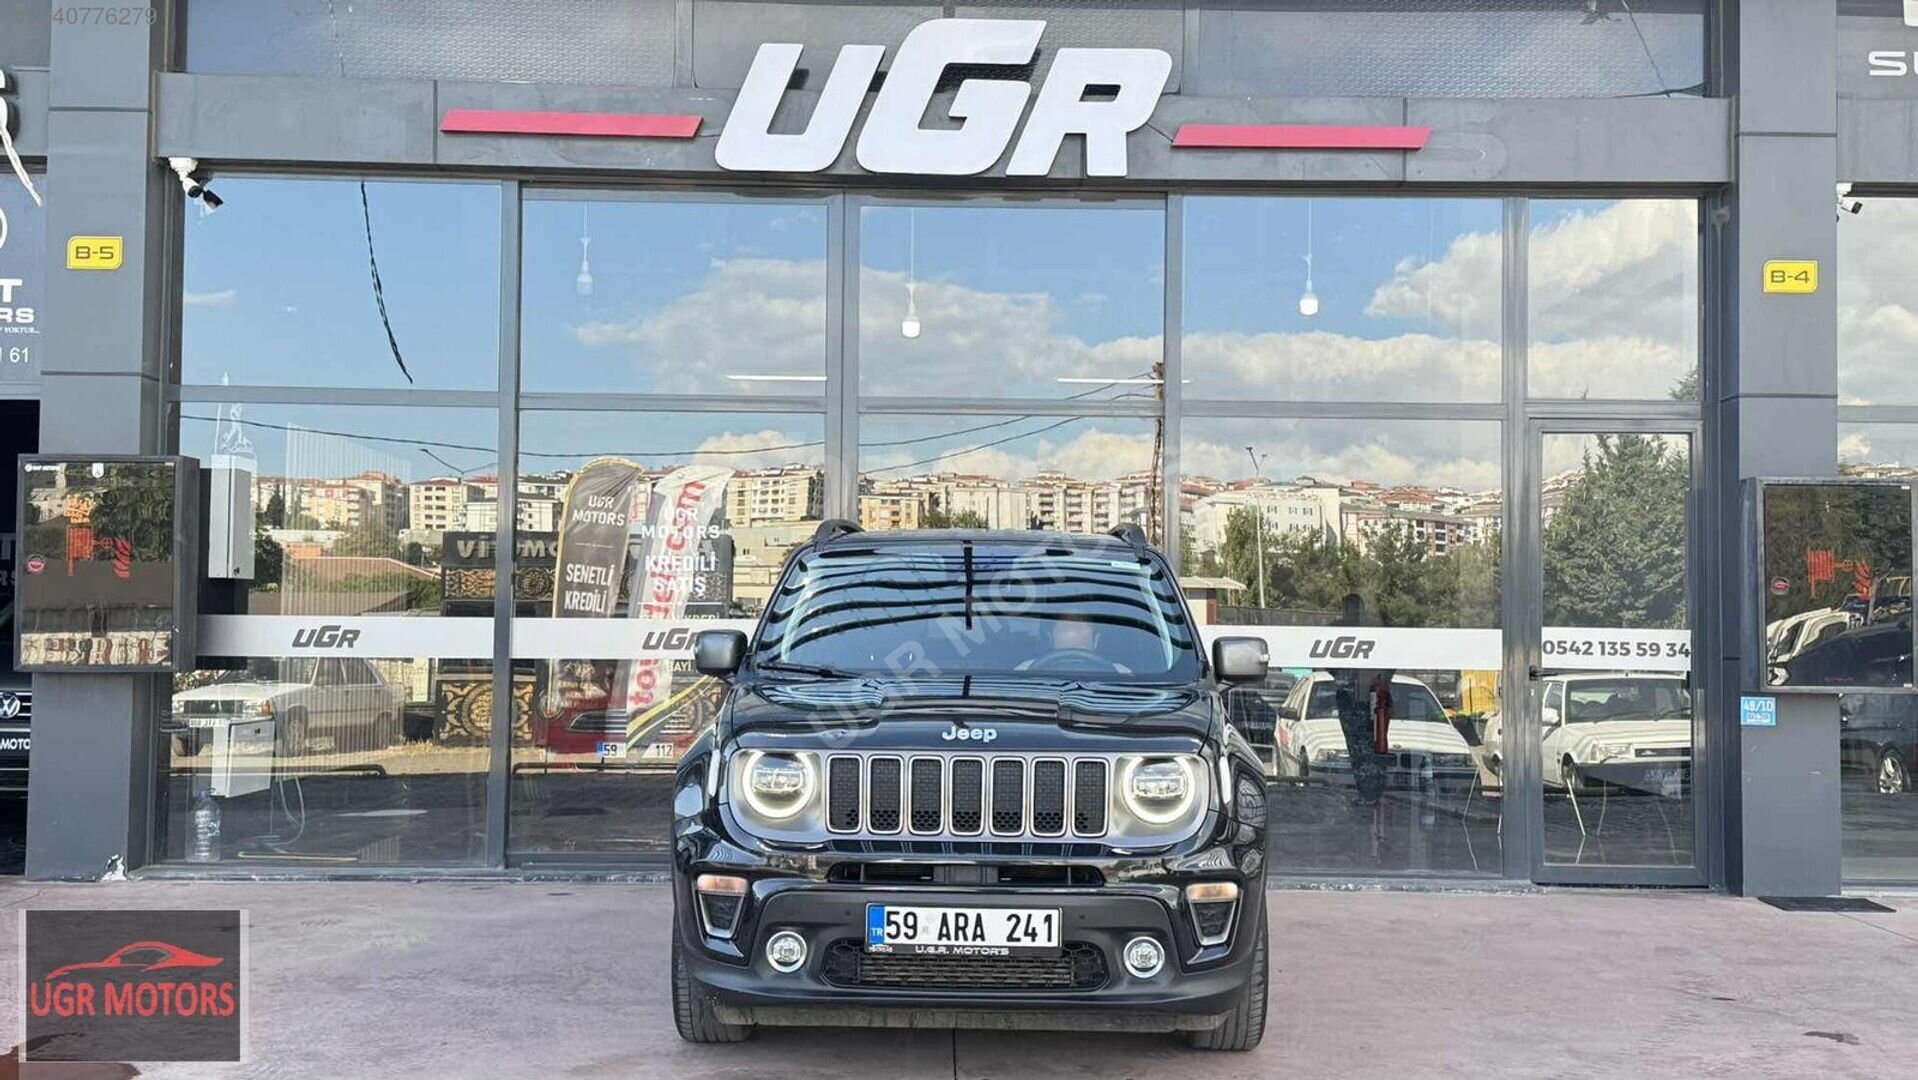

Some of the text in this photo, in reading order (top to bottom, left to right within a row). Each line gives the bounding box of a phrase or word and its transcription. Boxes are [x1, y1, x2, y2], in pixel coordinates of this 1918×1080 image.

[1868, 51, 1918, 76] S
[714, 18, 1173, 177] UGR
[75, 246, 114, 260] B-5
[1770, 270, 1810, 284] B-4
[588, 495, 615, 509] UGR
[572, 509, 625, 527] MOTORS
[664, 507, 698, 520] UGR
[641, 524, 720, 539] MOTORS
[645, 551, 716, 572] KREDİLİ
[565, 563, 615, 587] SENETLİ
[654, 575, 707, 599] SATIŞ
[564, 589, 608, 612] KREDİLİ
[292, 624, 361, 648] UGR
[642, 627, 700, 651] UG
[1309, 636, 1376, 660] UGR
[1542, 639, 1692, 658] 0542 135 59 34
[941, 725, 998, 743] Jeep
[871, 911, 1053, 942] TR 59 ARA 241
